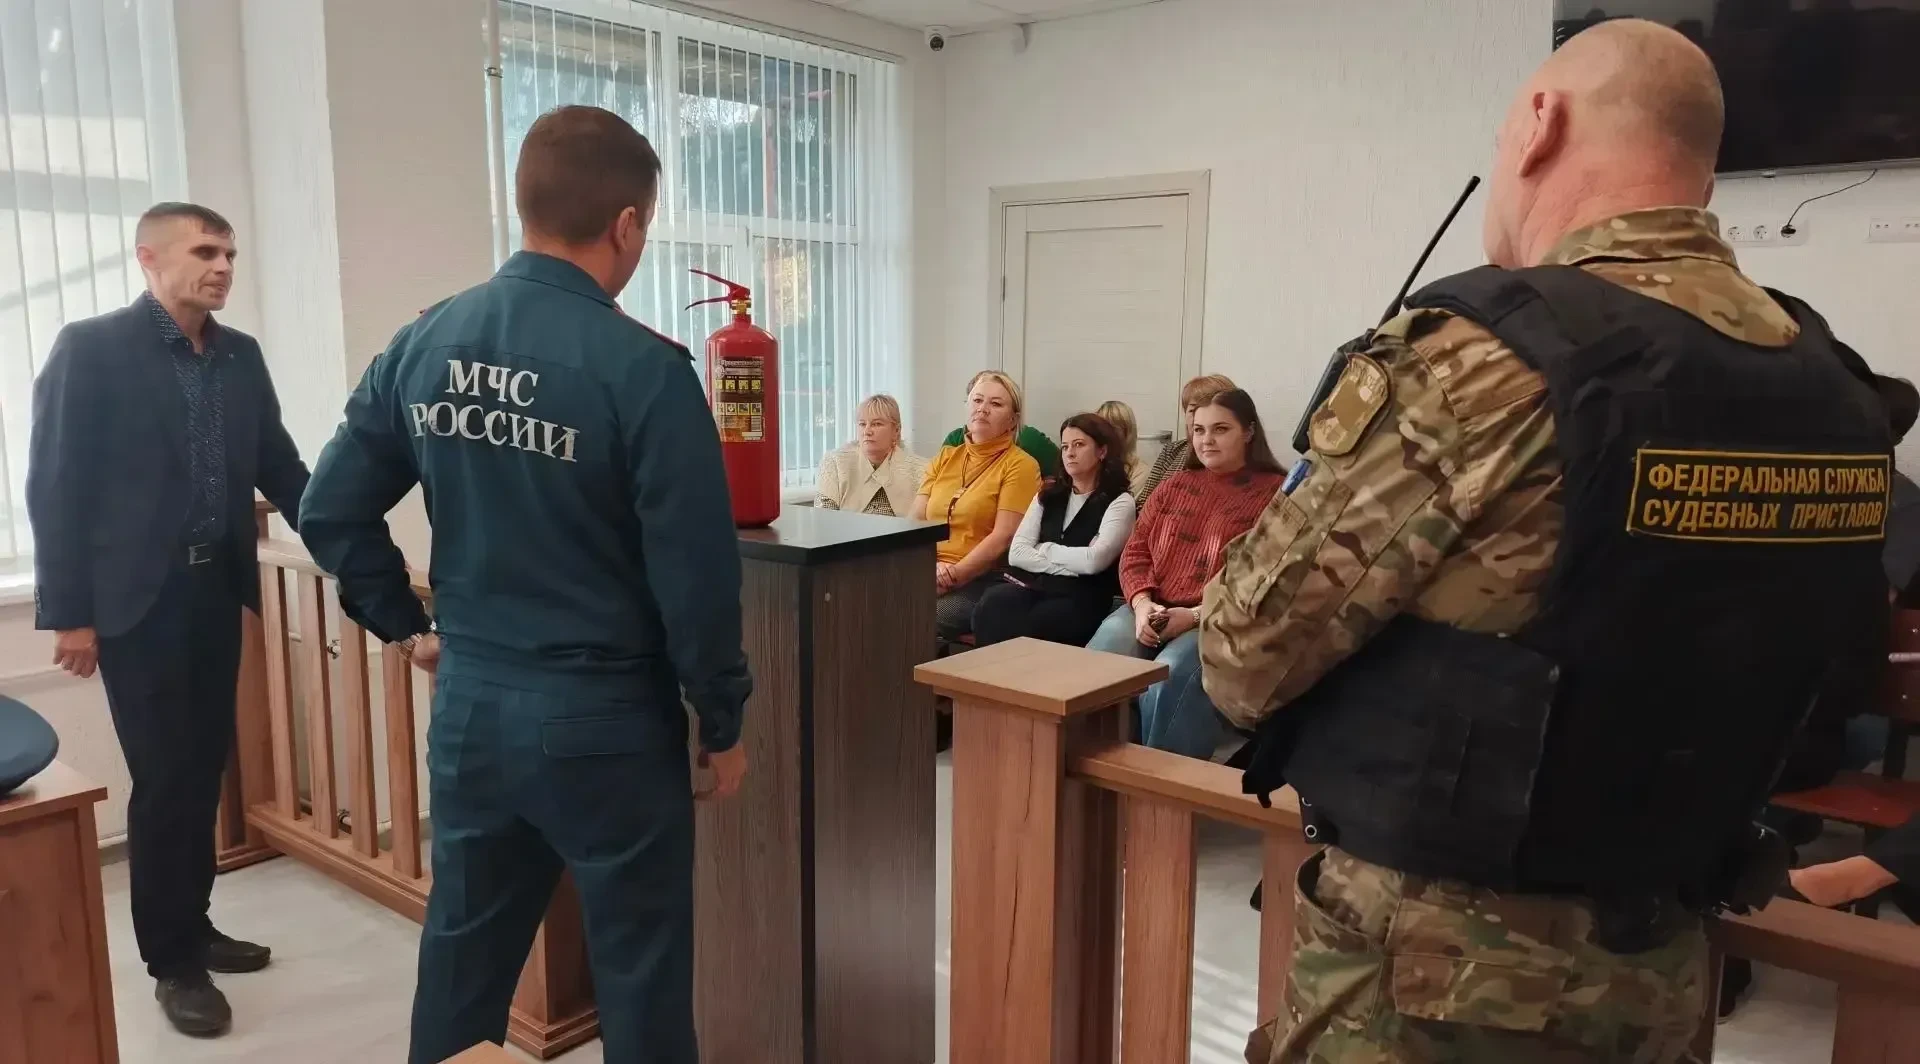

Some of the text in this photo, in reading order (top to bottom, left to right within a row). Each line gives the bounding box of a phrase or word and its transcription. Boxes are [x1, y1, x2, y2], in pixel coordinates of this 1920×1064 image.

[445, 359, 539, 407] МЧС
[409, 401, 581, 462] РОССИИ
[1648, 463, 1886, 497] ФЕДЕРАЛЬНАЯ СЛУЖБА
[1642, 499, 1883, 532] СУДЕБНЫХ ПРИСТАВОВ
